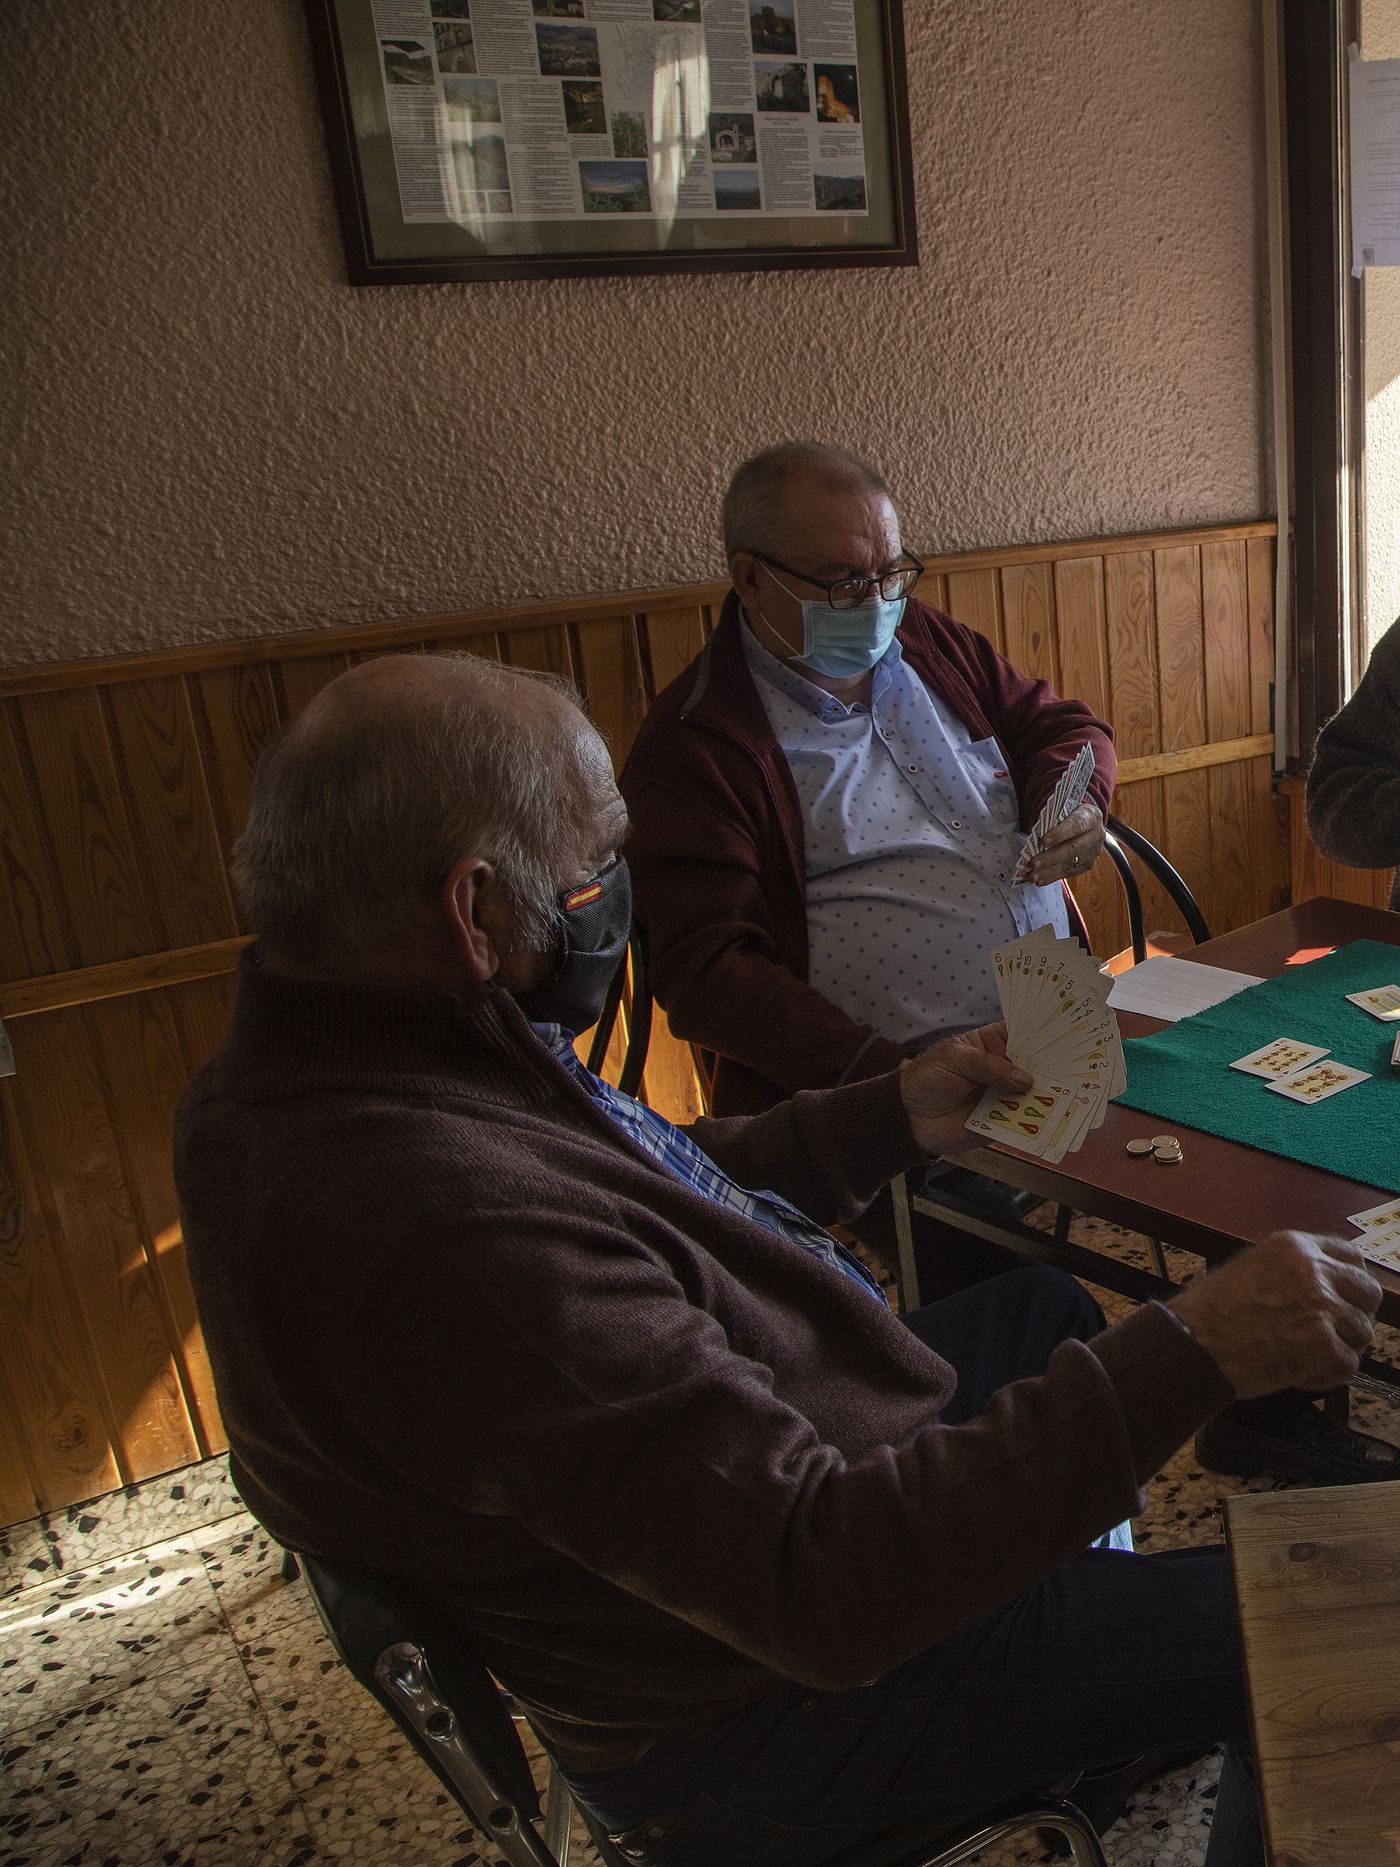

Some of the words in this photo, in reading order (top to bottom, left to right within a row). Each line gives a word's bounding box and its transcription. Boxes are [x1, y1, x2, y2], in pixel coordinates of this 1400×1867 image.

[994, 952, 1002, 963] 6
[1024, 955, 1032, 966] 10
[1040, 956, 1047, 967] 9
[1056, 962, 1065, 973] 7
[1065, 979, 1075, 990] 5
